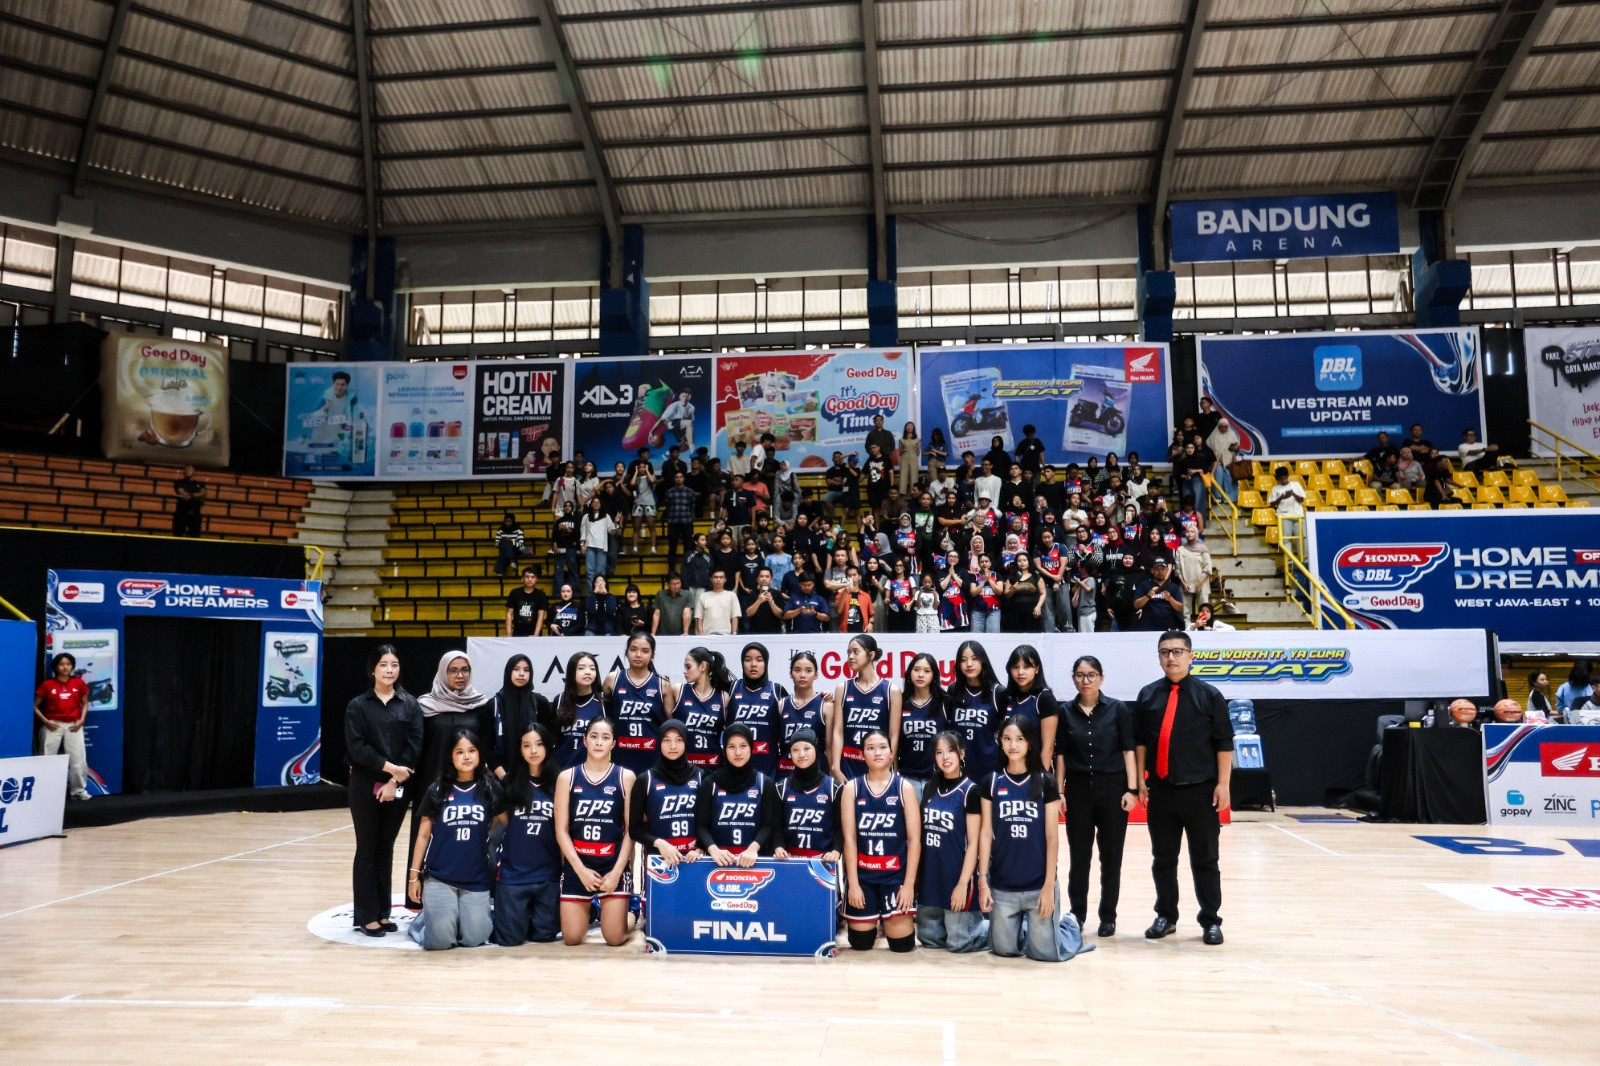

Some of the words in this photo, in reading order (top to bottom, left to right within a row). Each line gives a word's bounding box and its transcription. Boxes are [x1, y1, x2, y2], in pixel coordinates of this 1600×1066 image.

[1197, 203, 1371, 235] BANDUNG
[1226, 235, 1343, 253] ARENA
[140, 345, 177, 361] Good
[180, 349, 207, 368] Day
[1545, 351, 1561, 361] PAKE
[138, 366, 208, 380] ORIGINAL
[846, 367, 875, 379] Good
[876, 366, 898, 380] Day
[1320, 357, 1357, 374] DBL
[1564, 363, 1582, 375] GAYA
[483, 371, 530, 394] HOT
[531, 372, 551, 393] IN
[1320, 372, 1356, 382] PLAY
[840, 385, 857, 397] It's
[482, 395, 552, 416] CREAM
[826, 394, 866, 415] Good
[867, 393, 899, 411] Day
[1271, 396, 1372, 410] LIVESTREAM
[1375, 395, 1409, 407] AND
[1310, 410, 1372, 423] UPDATE
[1364, 554, 1421, 563] HONDA
[1453, 546, 1568, 567] HOME
[1365, 568, 1393, 582] DBL
[1454, 569, 1600, 590] DREAM
[165, 584, 221, 596] HOME
[165, 595, 270, 609] DREAMERS
[1370, 596, 1398, 606] Good
[1400, 595, 1421, 608] Day
[1454, 598, 1493, 608] WEST
[1494, 598, 1569, 607] JAVA-EAST
[562, 619, 571, 627] 27
[1191, 650, 1220, 660] ANG
[1222, 650, 1269, 660] WORTH
[1270, 650, 1288, 661] IT,
[1290, 650, 1308, 660] YA
[1308, 650, 1347, 659] CUMA
[820, 651, 893, 680] God
[619, 700, 653, 716] GPS
[734, 704, 770, 720] GPS
[846, 707, 881, 724] GPS
[685, 711, 719, 728] GPS
[954, 707, 989, 726] GPS
[629, 723, 643, 737] 91
[903, 719, 938, 735] GPS
[966, 729, 974, 740] 3
[695, 734, 709, 749] 31
[913, 740, 924, 751] 31
[575, 799, 615, 817] GPS
[660, 794, 697, 814] GPS
[718, 802, 758, 821] GPS
[998, 800, 1039, 819] GPS
[1543, 798, 1577, 811] ZINC
[442, 804, 485, 823] GPS
[788, 808, 826, 826] GPS
[1500, 808, 1533, 818] gopay
[526, 822, 542, 836] 27
[671, 820, 689, 837] 99
[858, 812, 897, 831] GPS
[456, 827, 471, 841] 10
[583, 824, 602, 841] 66
[732, 828, 742, 845] 9
[1010, 824, 1028, 838] 99
[797, 833, 811, 849] 71
[867, 839, 885, 856] 14
[926, 832, 941, 848] 66
[724, 884, 742, 893] DBL
[727, 901, 743, 909] Good
[744, 902, 757, 911] Day
[693, 920, 787, 942] FINAL
